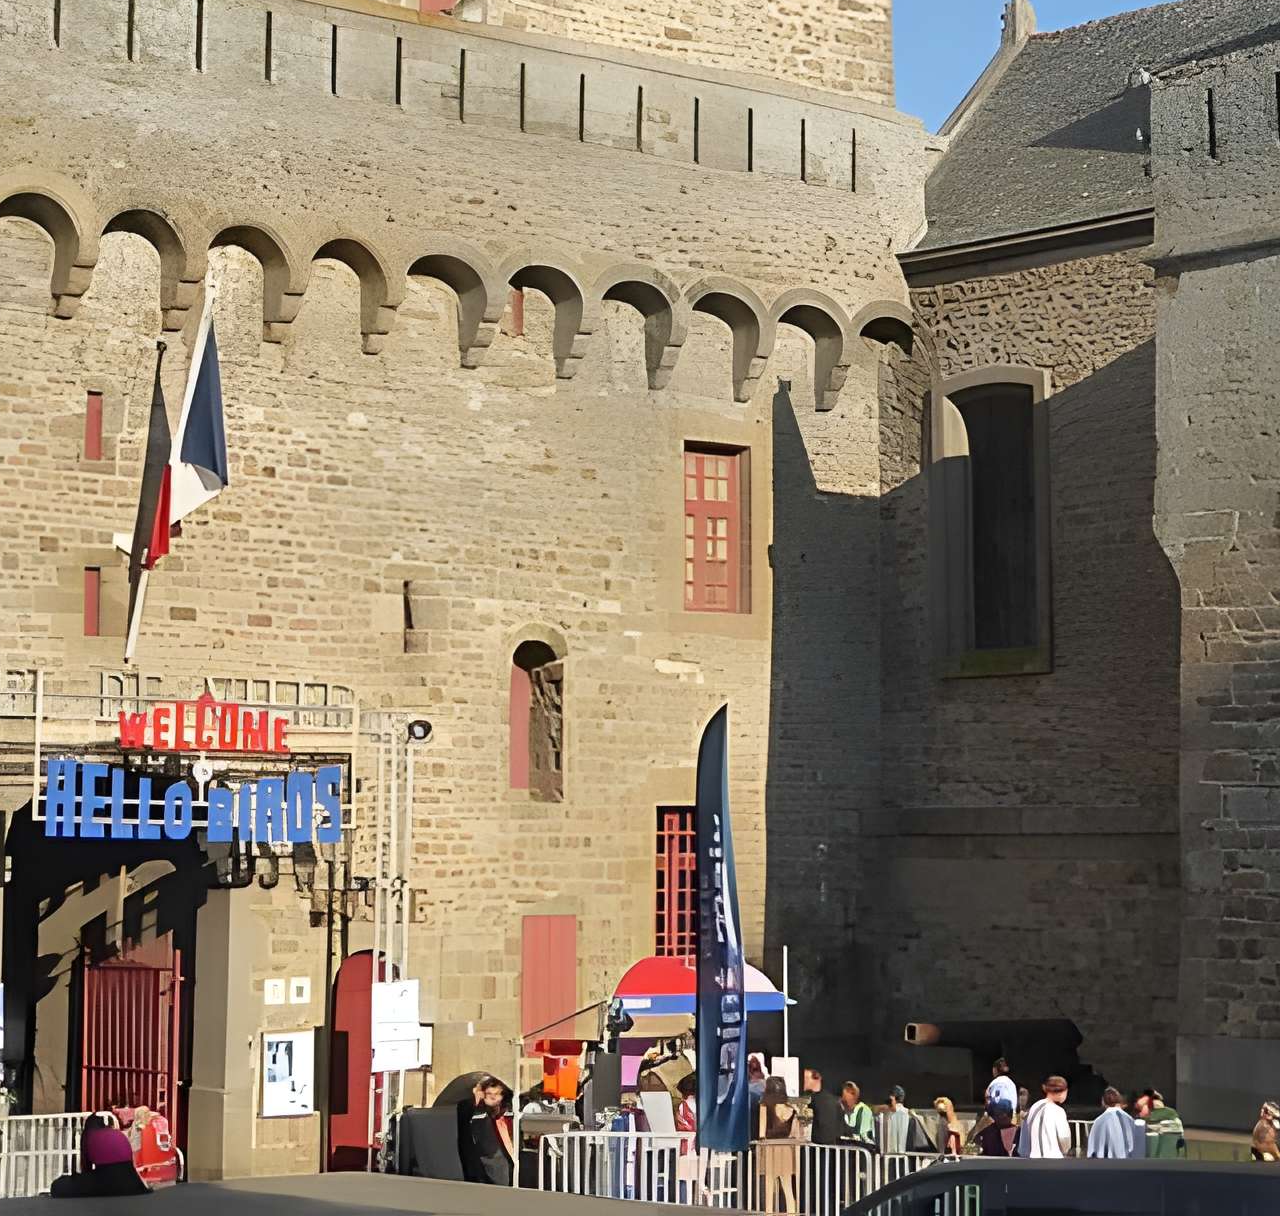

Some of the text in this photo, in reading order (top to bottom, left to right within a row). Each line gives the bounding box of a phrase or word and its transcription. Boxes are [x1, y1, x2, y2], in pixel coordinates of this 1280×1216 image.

[118, 697, 291, 753] WELCOME
[45, 759, 342, 843] HELLO BIRDS
